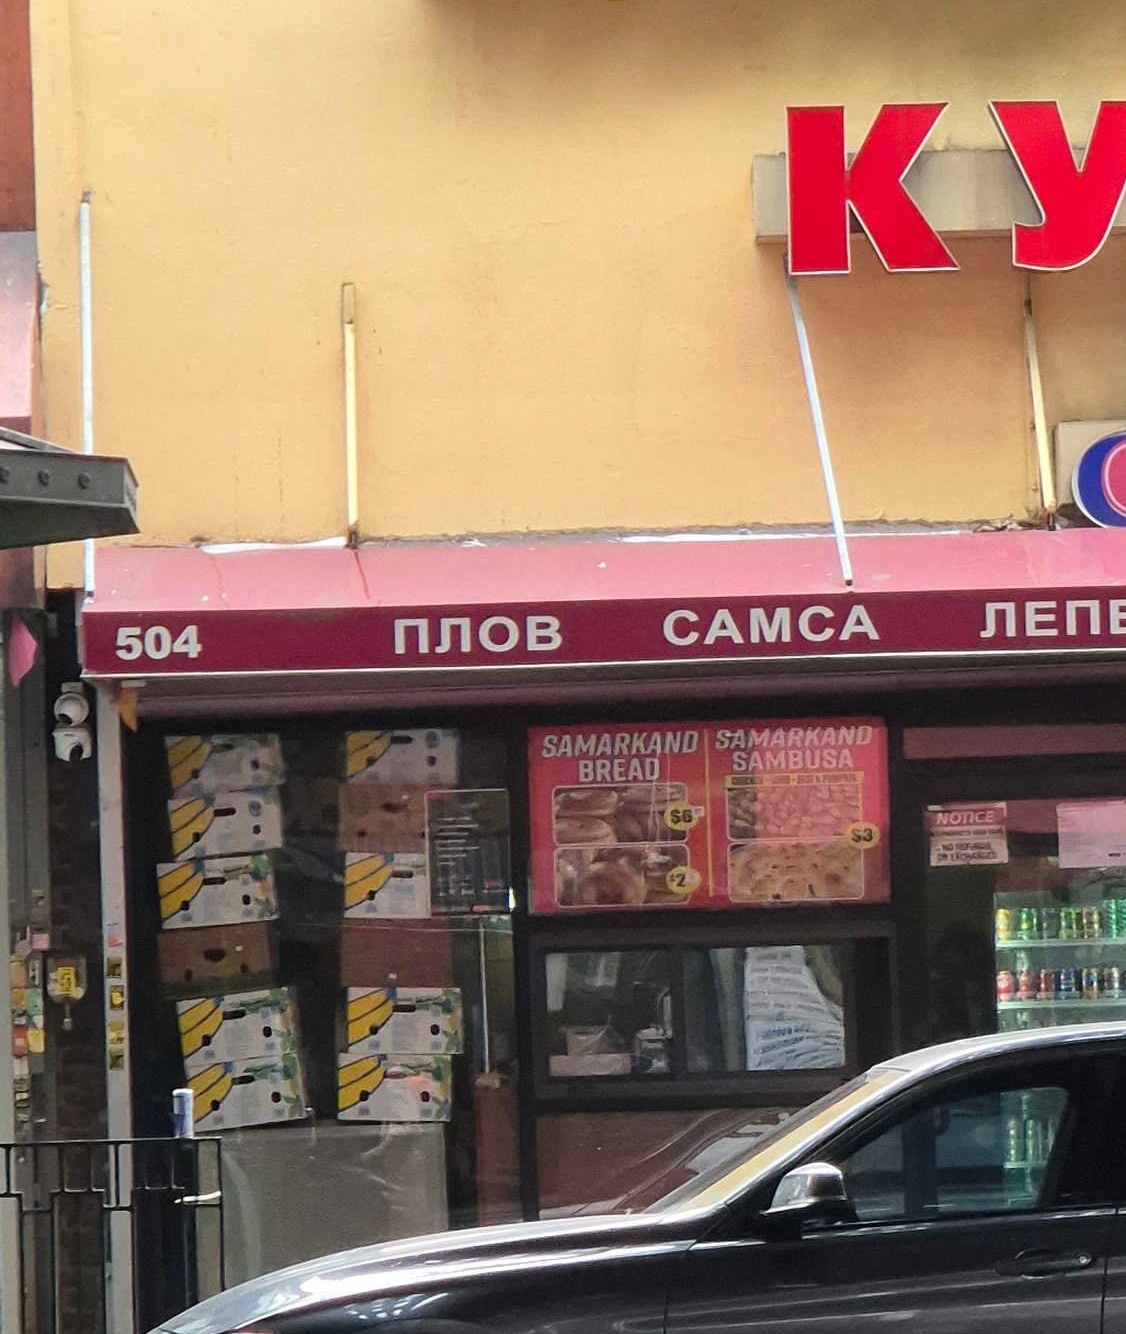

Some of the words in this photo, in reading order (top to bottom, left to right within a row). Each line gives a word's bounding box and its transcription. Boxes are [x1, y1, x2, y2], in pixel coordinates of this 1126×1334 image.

[114, 625, 203, 661] 504
[393, 615, 563, 656] ПЛОВ
[661, 604, 880, 647] САМСА
[542, 730, 699, 758] SAMARKAND
[714, 725, 873, 750] SAMARKAND
[578, 758, 661, 783] BREAD
[732, 748, 854, 772] SAMBUSA
[935, 810, 995, 825] NOTICE
[850, 827, 874, 843] $3
